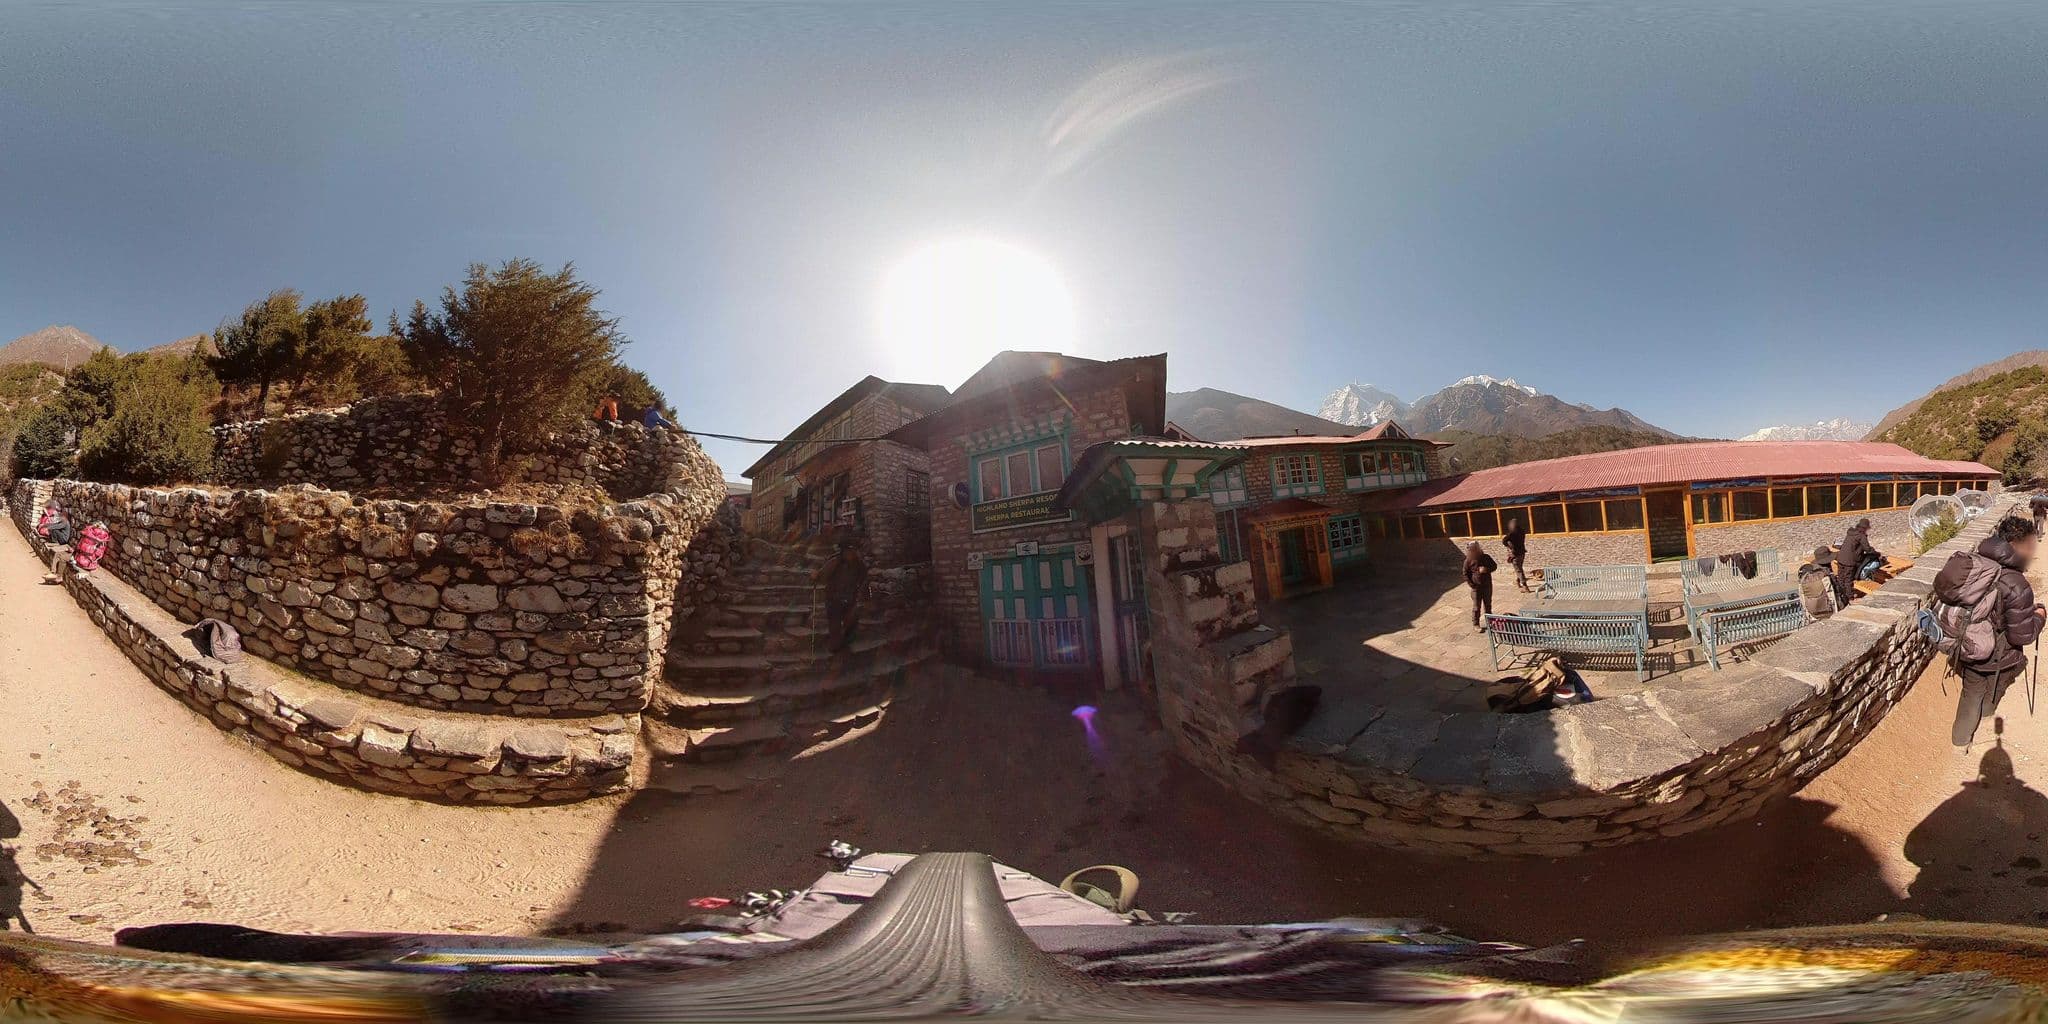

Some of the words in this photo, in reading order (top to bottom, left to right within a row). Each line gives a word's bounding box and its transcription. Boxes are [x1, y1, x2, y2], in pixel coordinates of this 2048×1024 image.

[977, 502, 1008, 512] HIGHLAND
[1009, 498, 1035, 508] SHERPA
[985, 513, 1009, 522] SHERPA
